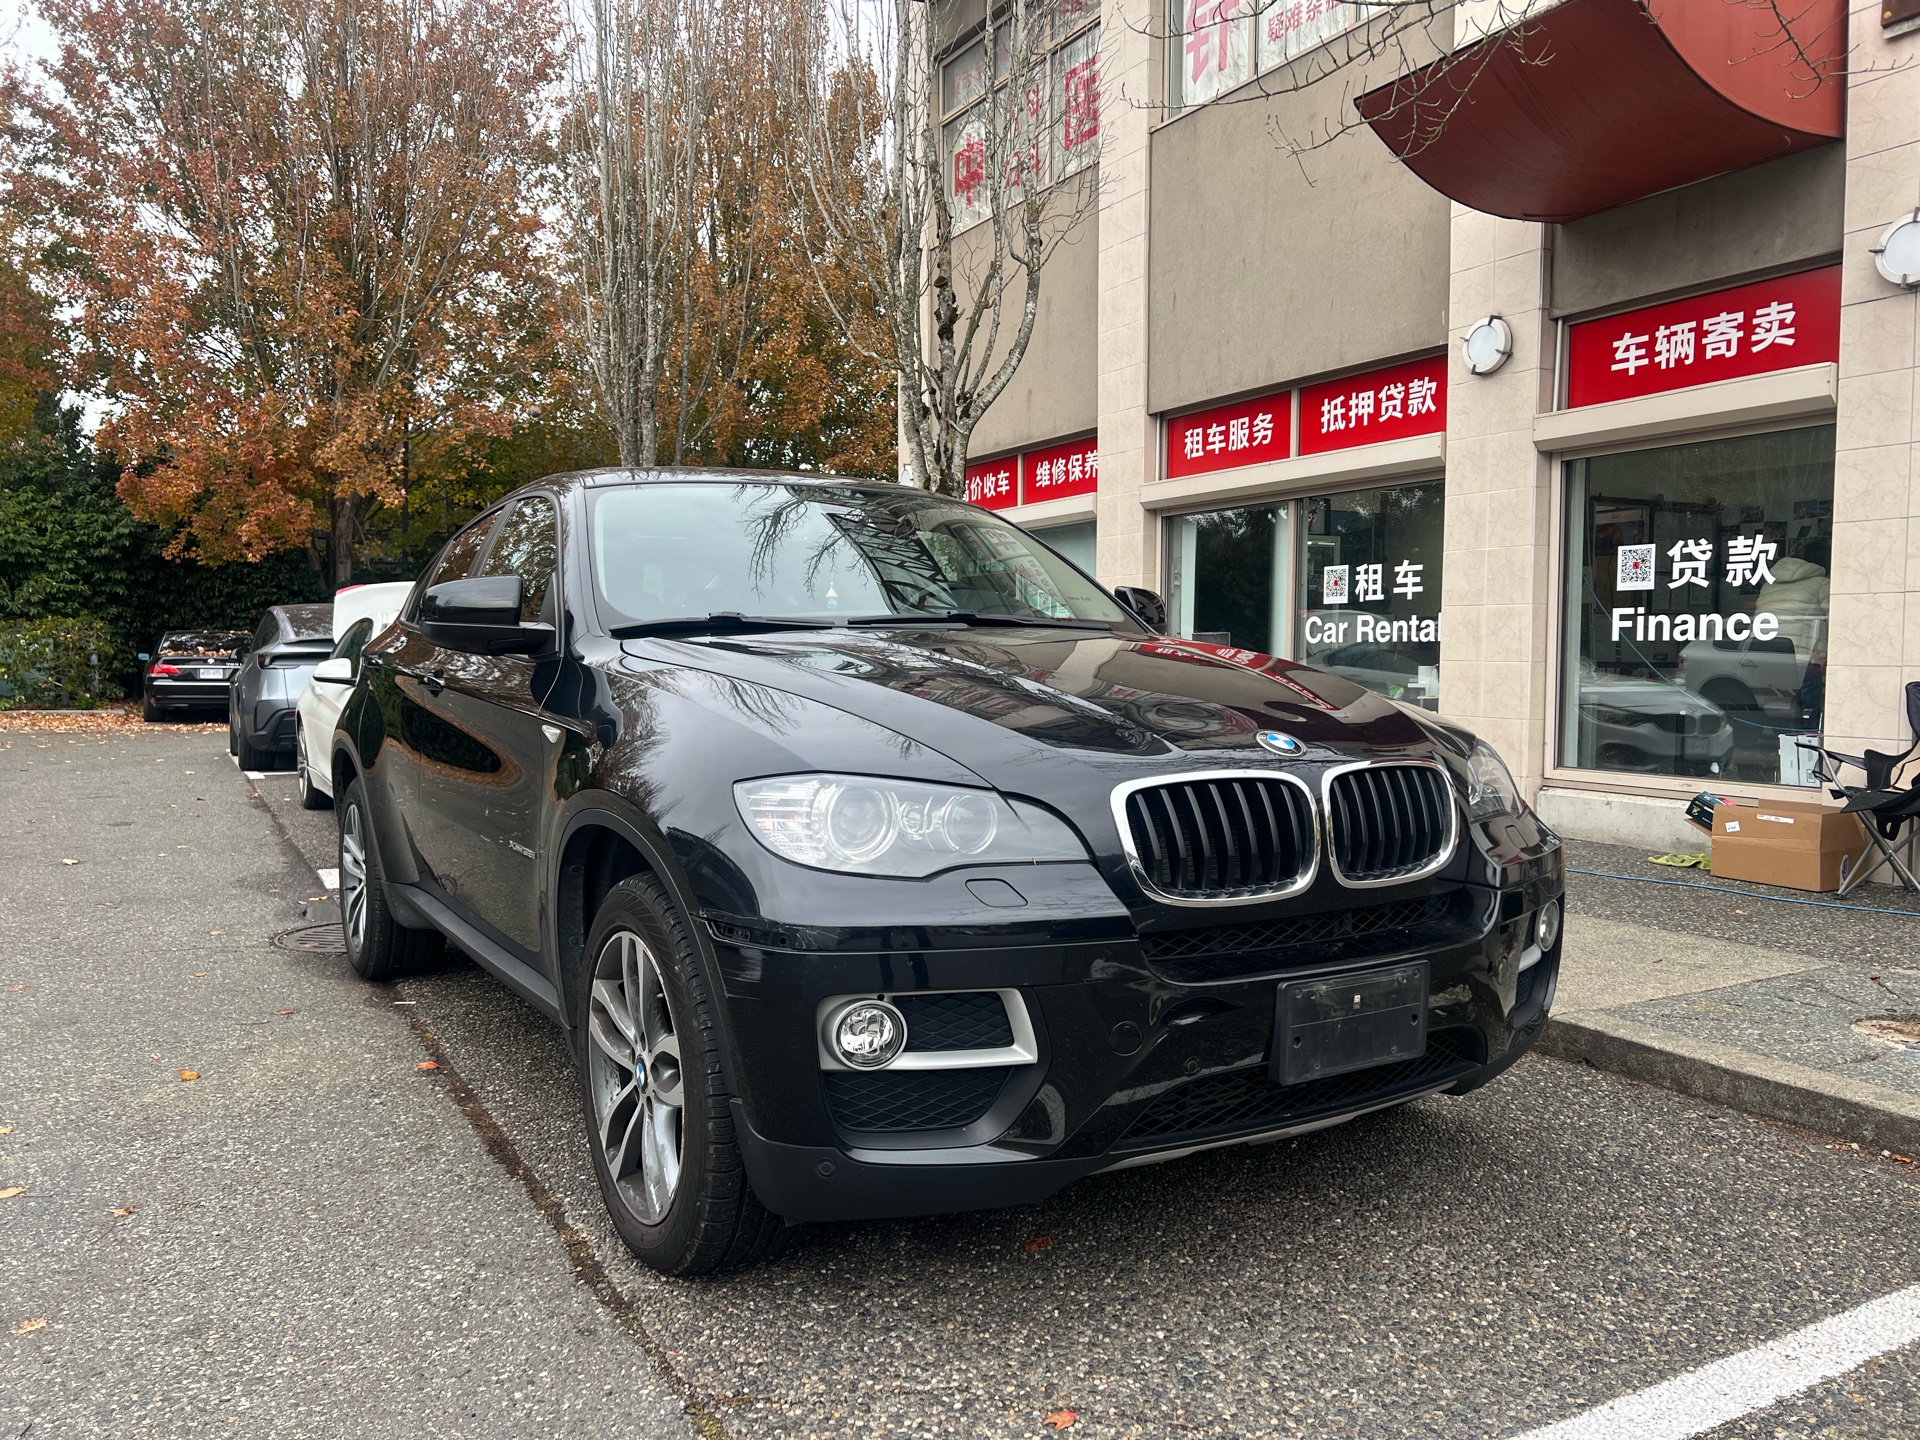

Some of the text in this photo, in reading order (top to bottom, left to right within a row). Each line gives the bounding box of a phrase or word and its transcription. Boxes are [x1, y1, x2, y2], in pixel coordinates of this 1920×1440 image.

[1610, 301, 1797, 375] 车辆寄卖
[1320, 376, 1437, 434] 抵押贷款
[1184, 412, 1275, 459] 租车服务
[1035, 449, 1098, 488] 维修保养
[1355, 559, 1424, 602] 租车
[1667, 534, 1778, 589] 贷款
[1304, 612, 1442, 644] Car Rental
[1611, 606, 1779, 643] Finance
